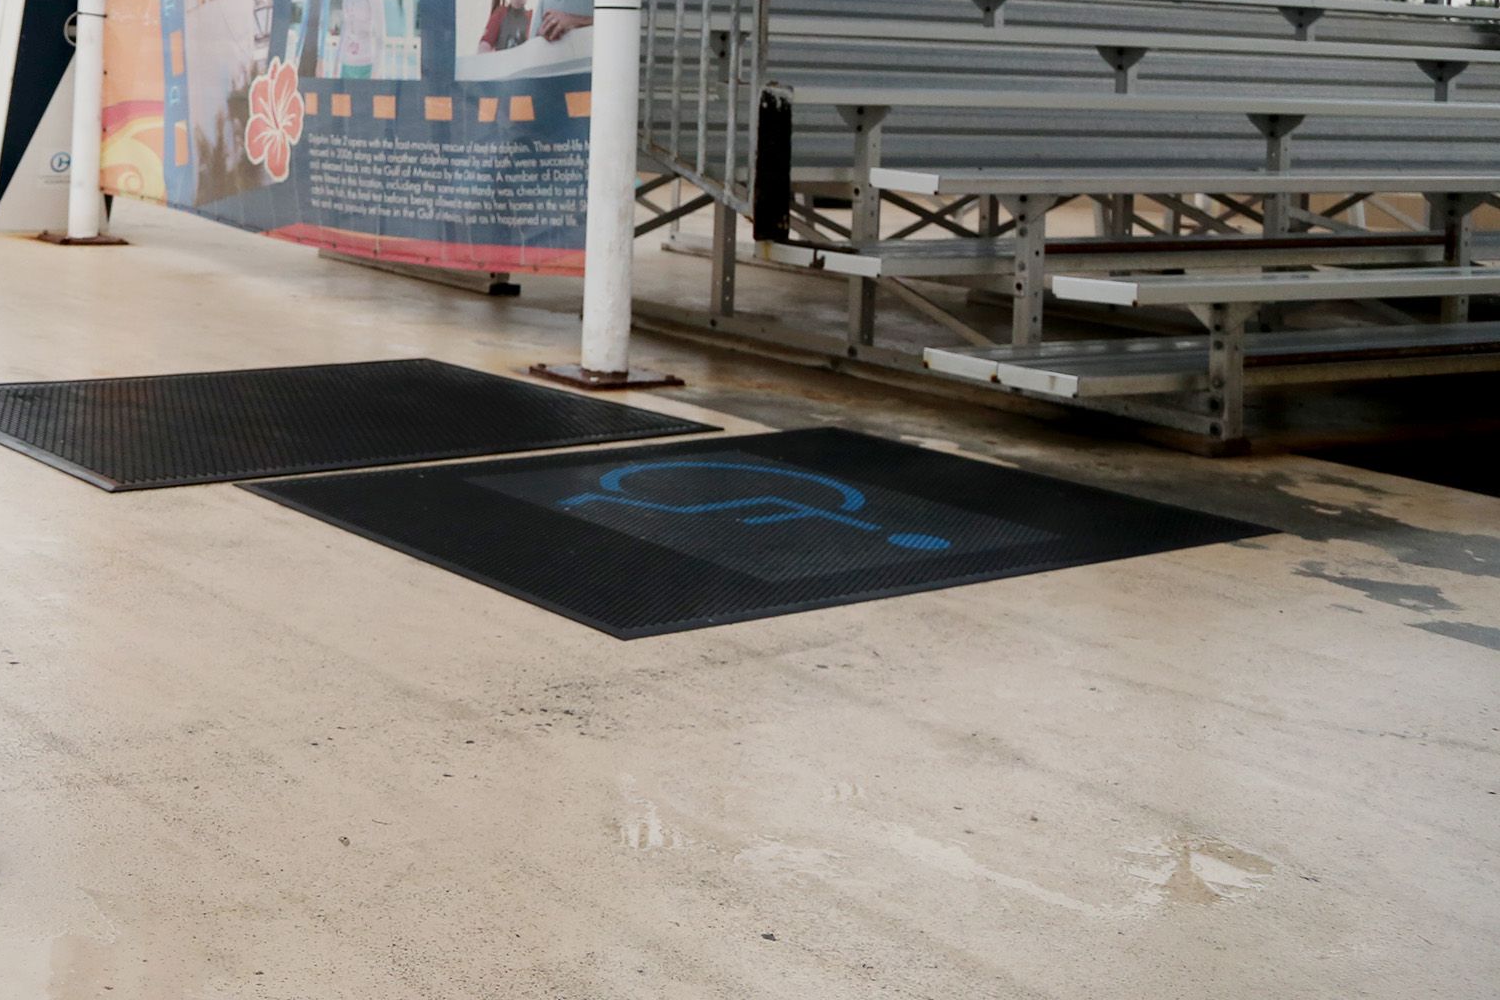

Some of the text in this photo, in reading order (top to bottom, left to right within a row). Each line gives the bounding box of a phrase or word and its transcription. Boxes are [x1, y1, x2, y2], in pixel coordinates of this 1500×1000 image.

[382, 138, 393, 149] the
[534, 140, 551, 152] The
[387, 152, 418, 163] another
[420, 153, 449, 167] dolphin
[514, 158, 537, 168] were
[384, 164, 401, 177] Gulf
[402, 165, 411, 177] of
[413, 166, 442, 179] Mexico
[496, 171, 504, 182] A
[505, 169, 538, 182] number
[541, 169, 551, 181] of
[553, 169, 583, 184] Dolphin
[423, 180, 436, 192] the
[497, 188, 514, 197] was
[516, 184, 553, 197] checked
[555, 186, 562, 196] to
[410, 193, 434, 208] being
[509, 198, 534, 210] home
[402, 207, 415, 218] the
[417, 207, 434, 220] Gulf
[497, 213, 539, 227] happened
